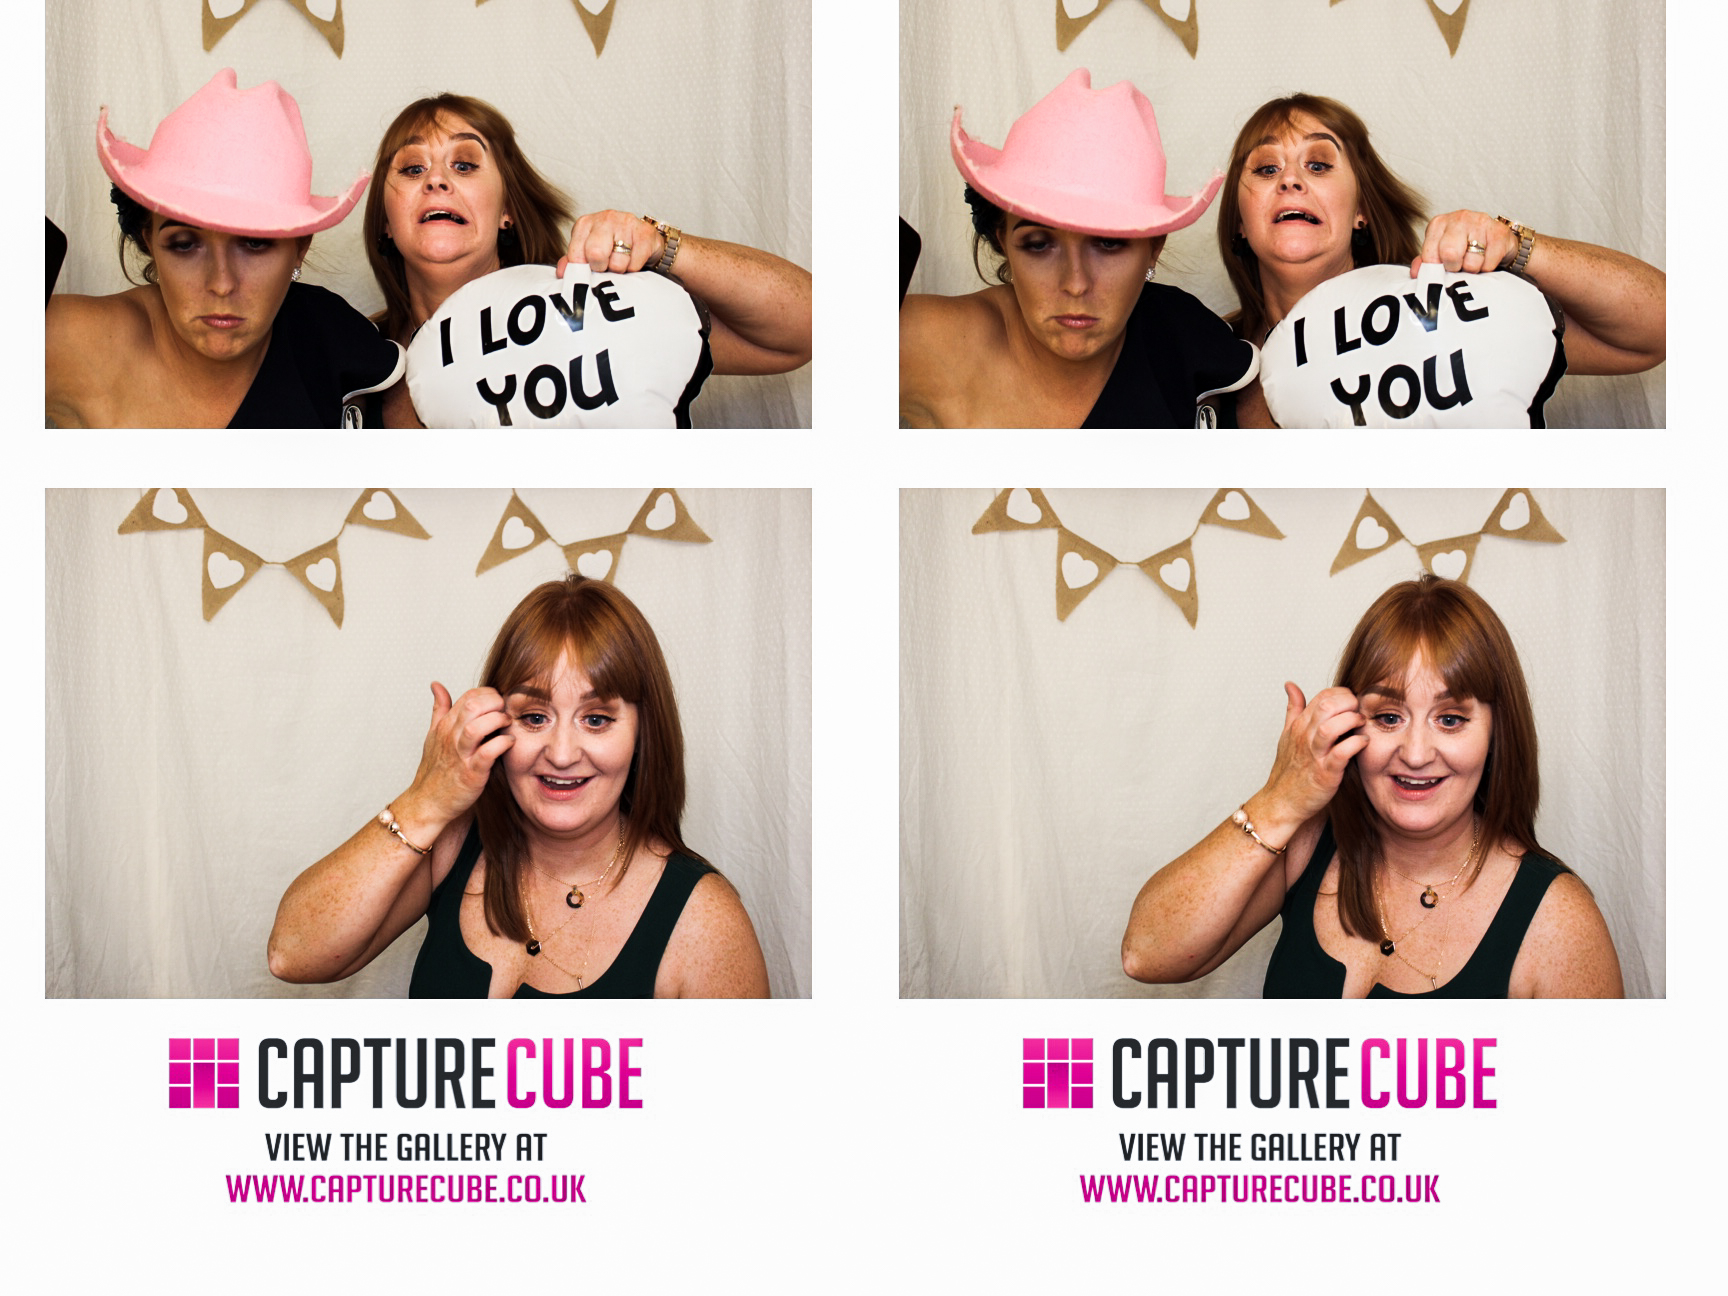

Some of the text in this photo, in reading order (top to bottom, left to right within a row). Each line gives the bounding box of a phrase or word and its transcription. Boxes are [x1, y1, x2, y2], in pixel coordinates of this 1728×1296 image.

[439, 280, 636, 367] I LOVE
[1293, 280, 1490, 367] I LOVE
[475, 348, 620, 427] YOU
[1329, 348, 1474, 427] YOU
